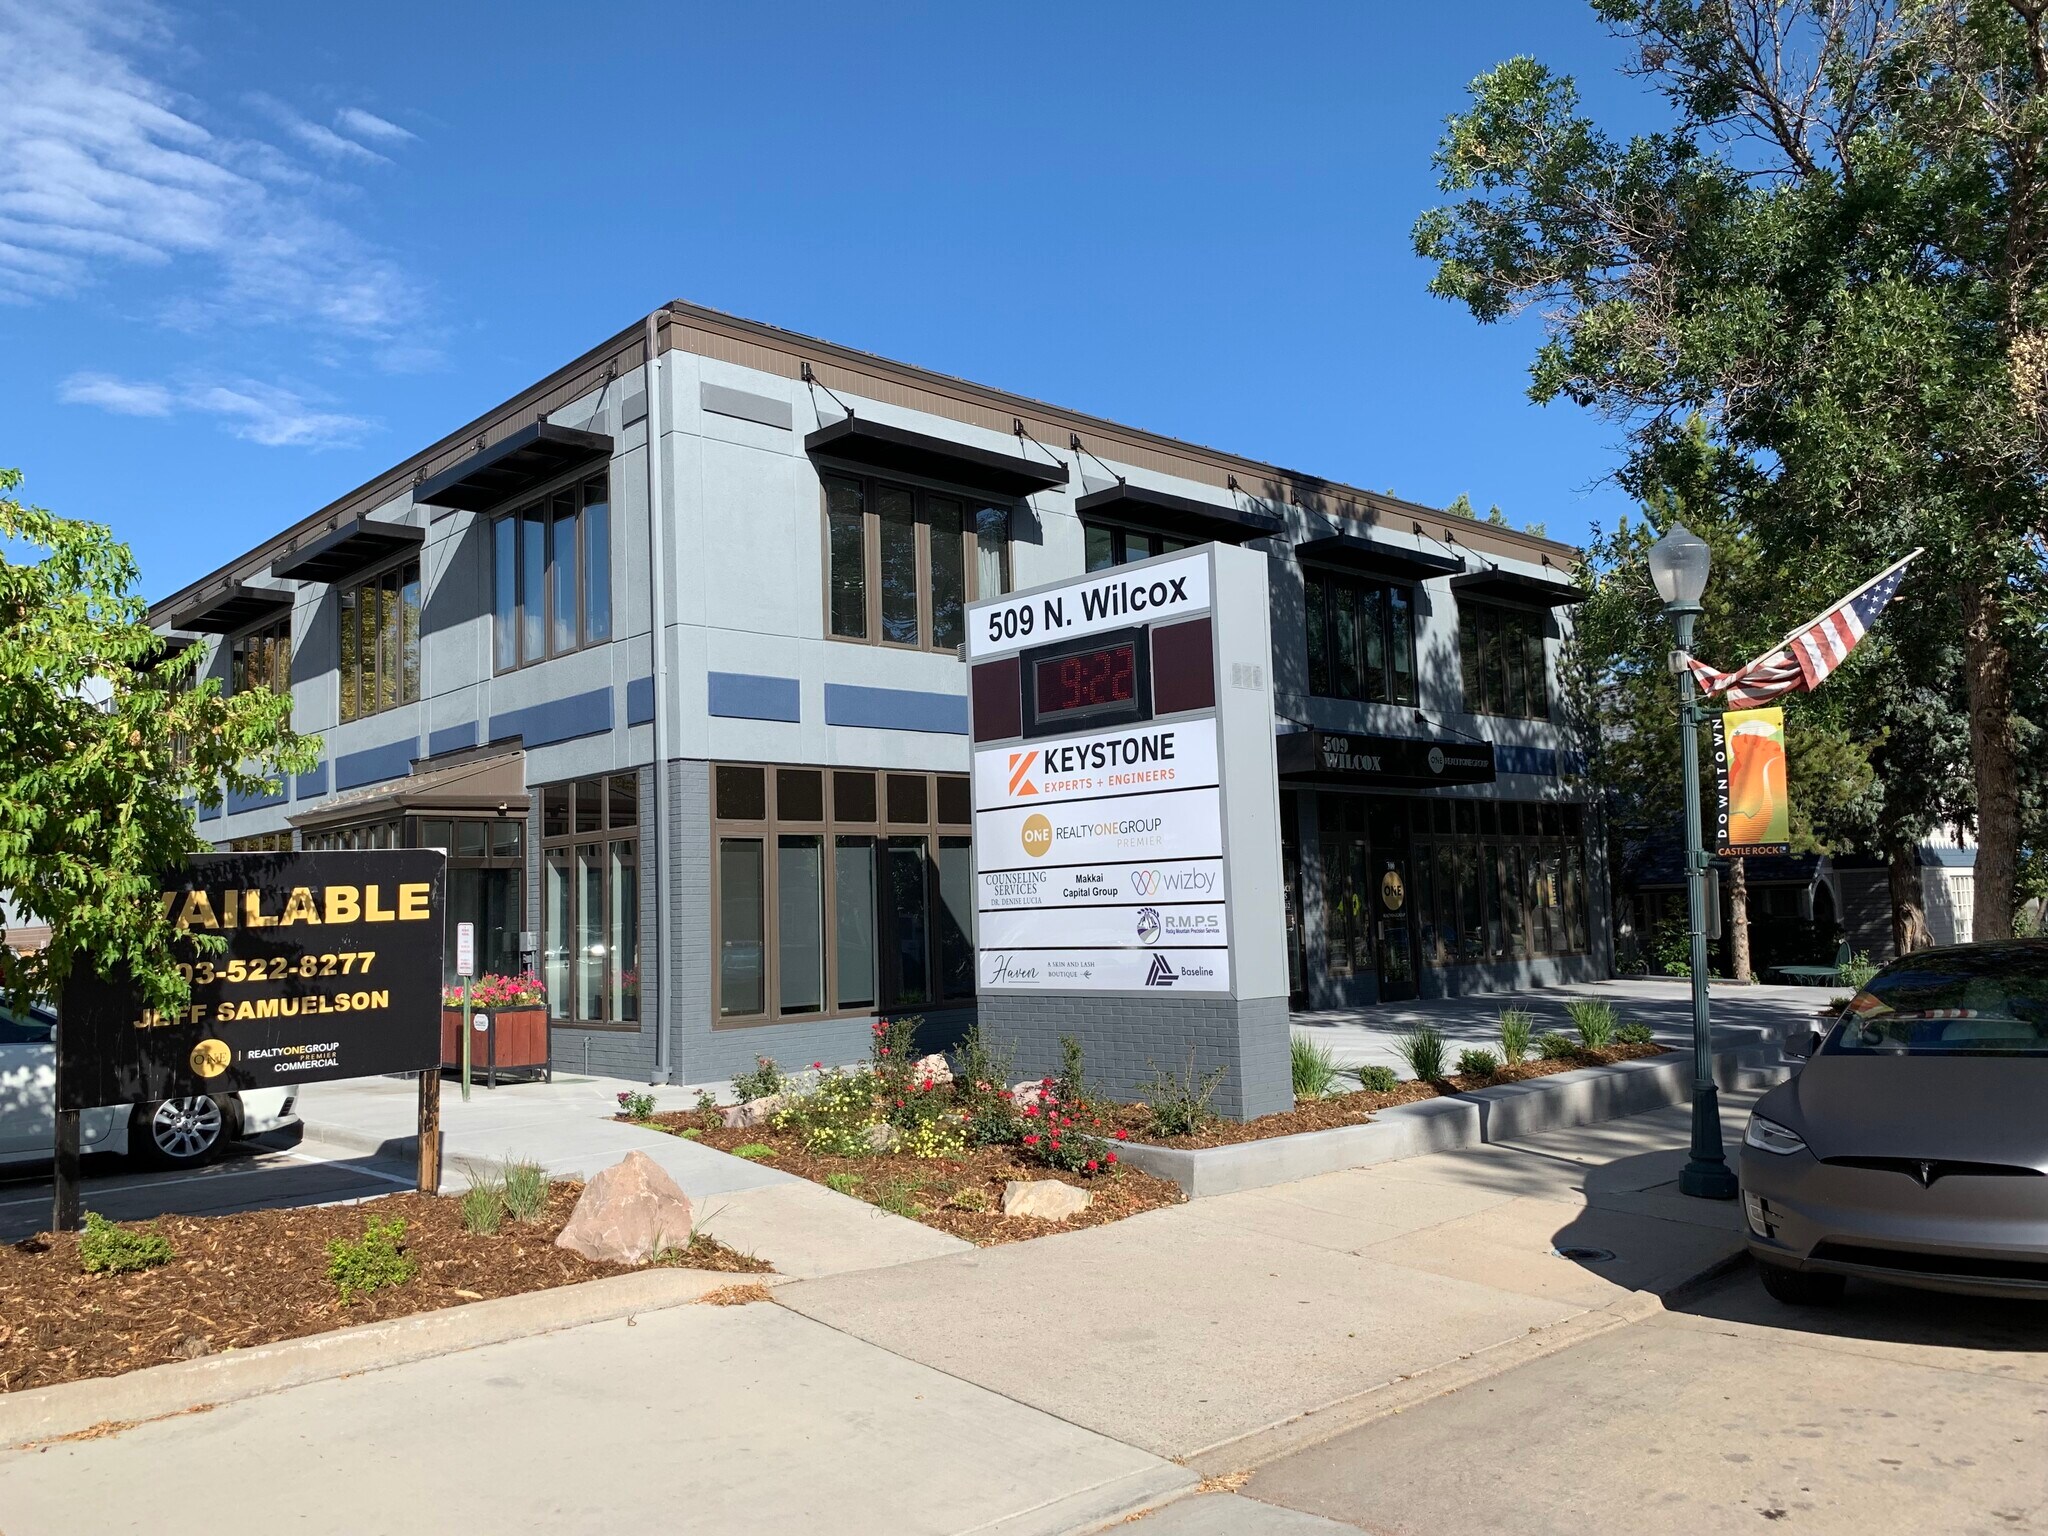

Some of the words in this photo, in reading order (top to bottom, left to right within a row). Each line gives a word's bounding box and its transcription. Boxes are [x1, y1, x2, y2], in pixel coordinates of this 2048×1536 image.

[988, 605, 1034, 642] 509
[1044, 597, 1072, 631] N.
[1081, 576, 1188, 622] Wilcox
[1059, 648, 1134, 709] 9:22
[1044, 732, 1175, 774] KEYSTONE
[1323, 736, 1348, 754] 509
[1323, 752, 1382, 771] WILCOX
[1044, 778, 1092, 793] EXPERTS
[1108, 768, 1176, 786] ENGINEERS
[1712, 718, 1728, 838] DOWNTOWN
[1024, 828, 1050, 843] ONE
[1056, 817, 1162, 840] REALTYONEGROUP
[1117, 835, 1162, 848] PREMIER
[1718, 847, 1750, 856] CASTLE
[1752, 846, 1779, 855] ROCK
[985, 871, 1047, 886] COUNSELING
[1075, 873, 1104, 884] Makkai
[1163, 868, 1216, 893] wizby
[994, 883, 1037, 896] SERVICES
[1063, 887, 1091, 899] Capital
[1092, 886, 1118, 898] Group
[1383, 885, 1402, 897] ONE
[160, 882, 430, 929] VAILABLE
[1002, 898, 1022, 906] DENISE
[1023, 897, 1042, 905] LUCIA
[174, 951, 376, 986] 03-522-8277
[989, 954, 1040, 984] Haven
[1181, 966, 1214, 976] Baseline
[217, 990, 389, 1023] SAMUELSON
[193, 1051, 227, 1066] ONE
[248, 1042, 340, 1060] REALTYONEGROUP
[300, 1051, 337, 1061] PREMIER
[274, 1058, 339, 1073] COMMERCIAL
